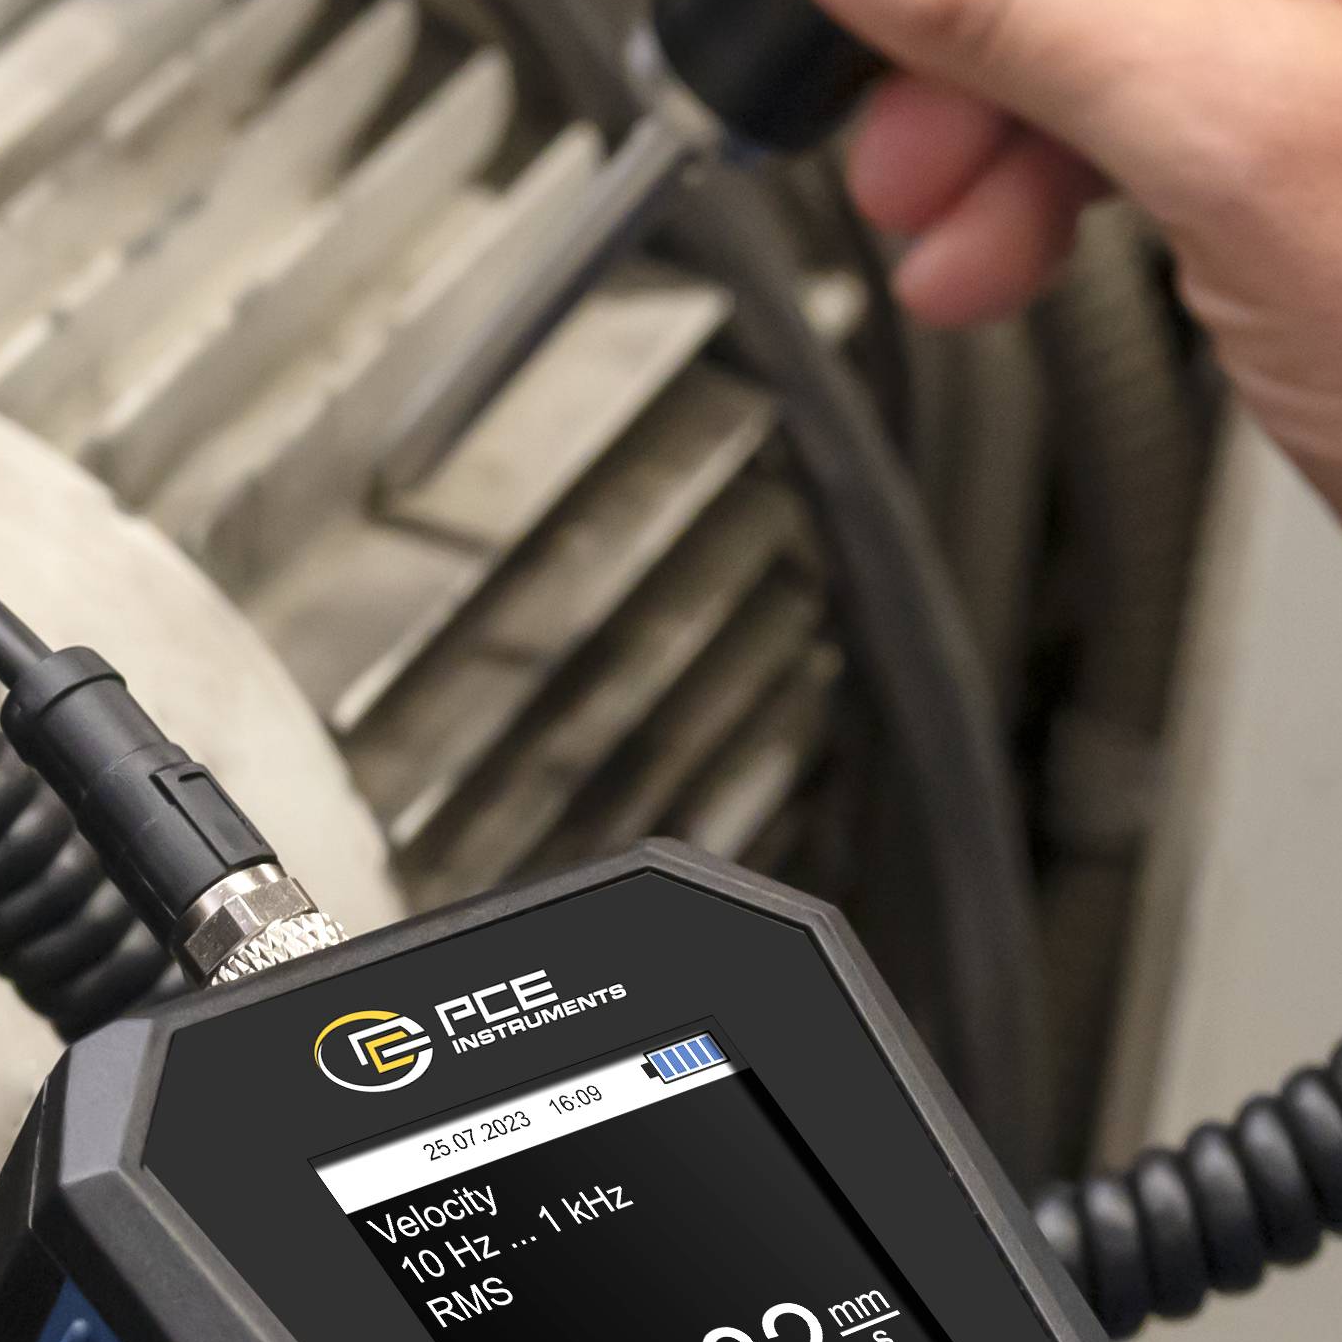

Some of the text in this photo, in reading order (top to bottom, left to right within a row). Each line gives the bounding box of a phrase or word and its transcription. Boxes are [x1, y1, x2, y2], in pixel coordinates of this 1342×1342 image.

[435, 969, 560, 1037] PCE
[451, 983, 627, 1055] INSTRUMENTS
[422, 1085, 603, 1162] 25.07.2023 16:09
[366, 1184, 498, 1245] Velocity
[401, 1249, 446, 1284] 10
[445, 1234, 501, 1268] Hz
[538, 1205, 562, 1233] 1
[560, 1184, 635, 1225] kHz
[425, 1276, 514, 1329] RMS
